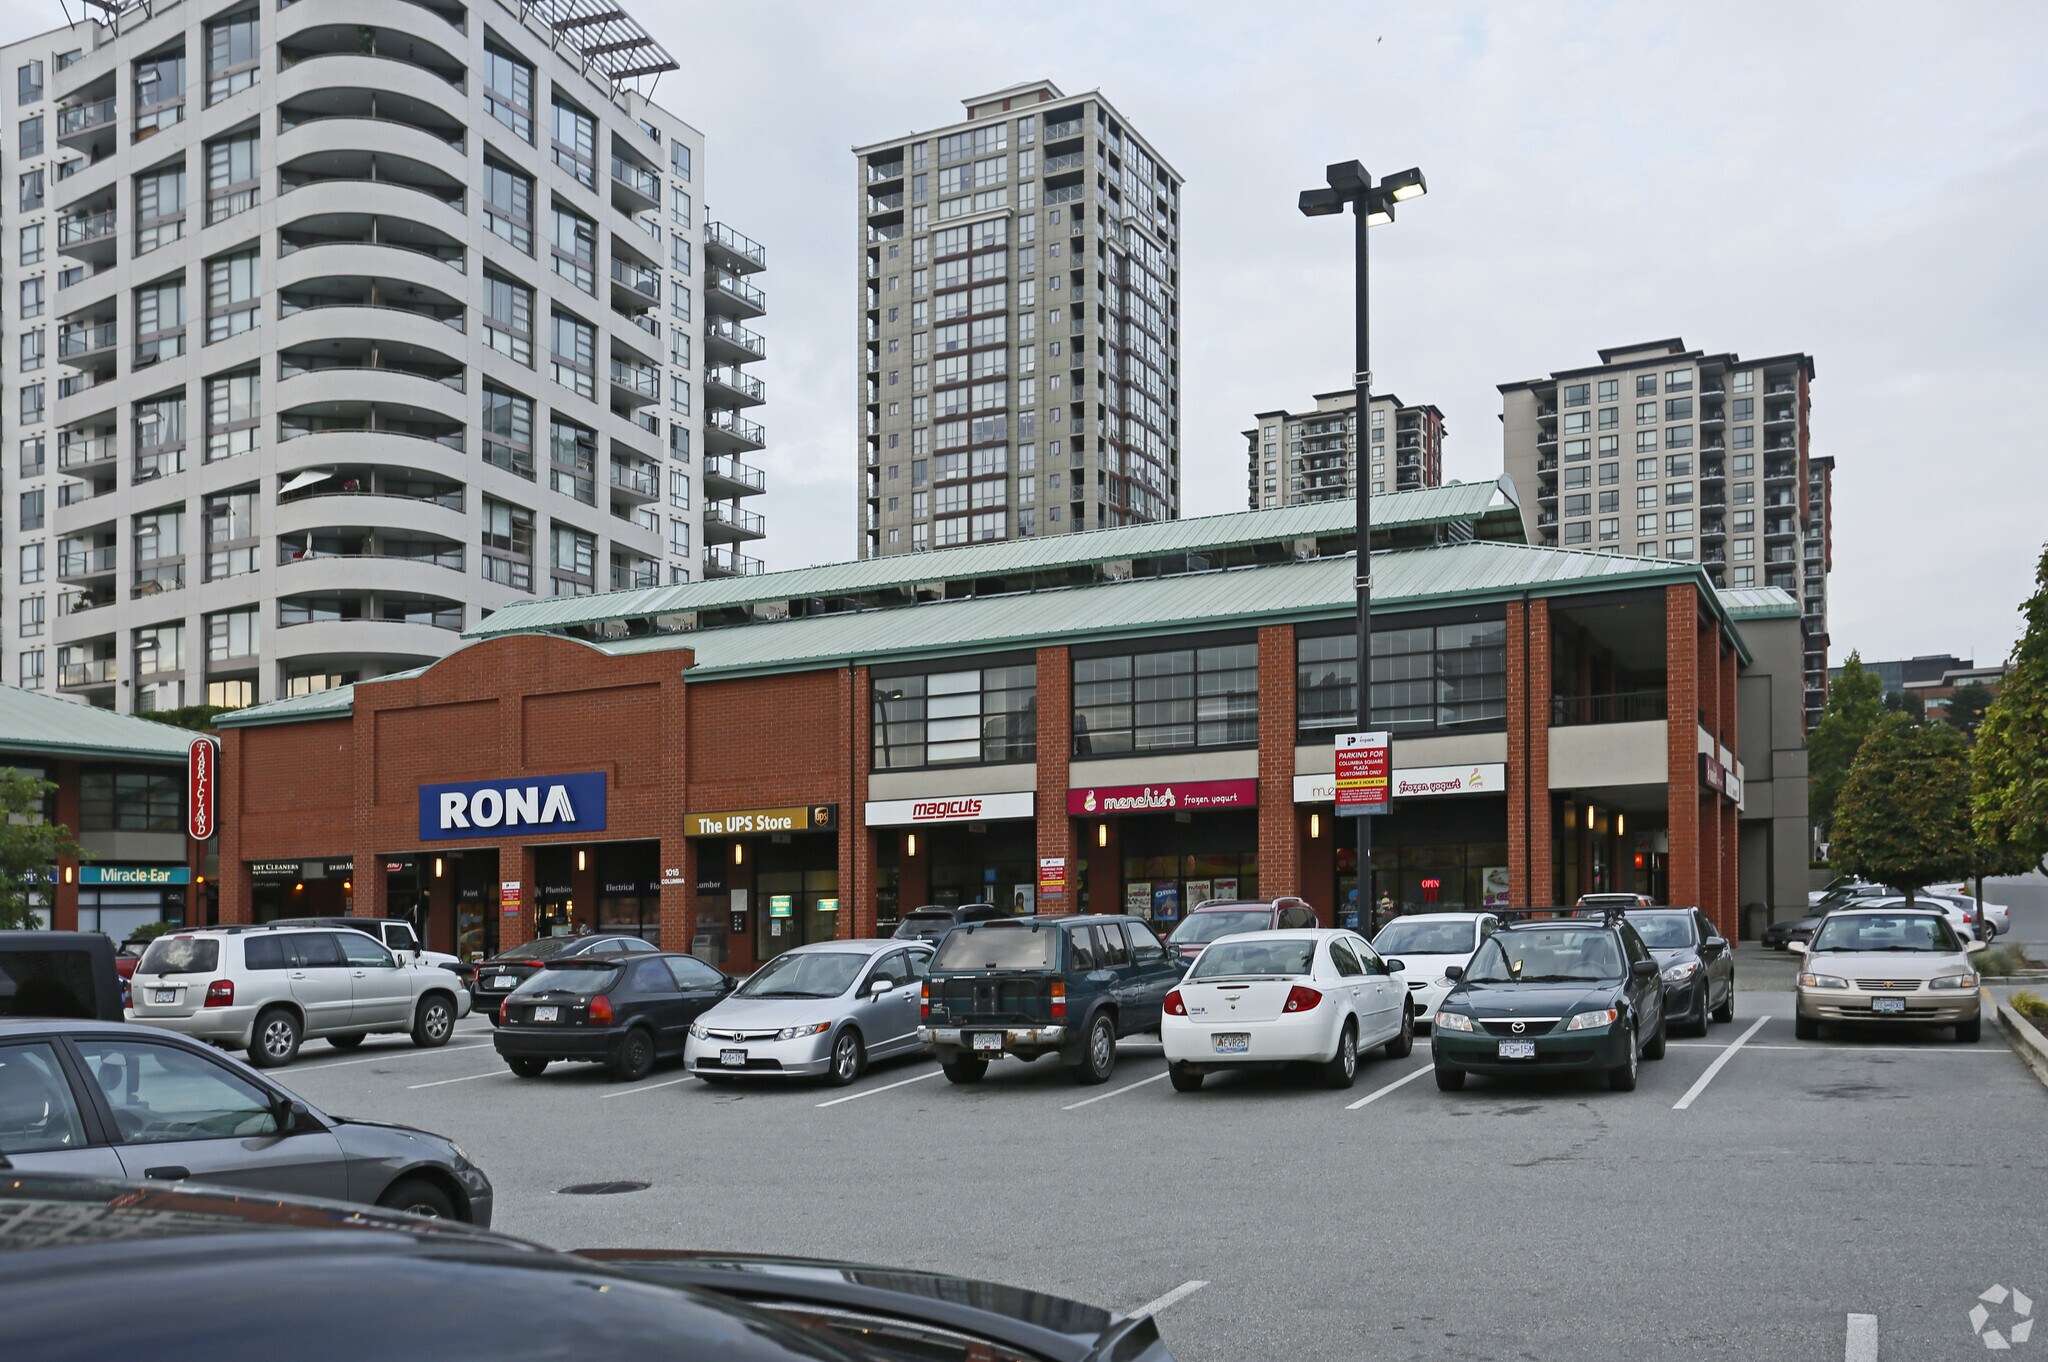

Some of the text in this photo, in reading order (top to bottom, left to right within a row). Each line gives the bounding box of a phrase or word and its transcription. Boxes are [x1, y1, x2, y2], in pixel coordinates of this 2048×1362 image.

[1338, 751, 1368, 759] PARKING
[195, 742, 207, 835] FABRICLAND
[1398, 780, 1429, 793] frozen
[1430, 779, 1461, 793] yogurt
[1104, 787, 1237, 810] menchie's frozen yogurt
[440, 785, 576, 829] RONA
[913, 799, 982, 818] magicuts
[699, 815, 791, 834] The UPS Store
[266, 863, 299, 871] CLEANERS
[665, 868, 680, 877] 1015
[605, 883, 635, 891] Electrical
[1421, 879, 1440, 888] OPEN
[463, 889, 478, 897] Paint
